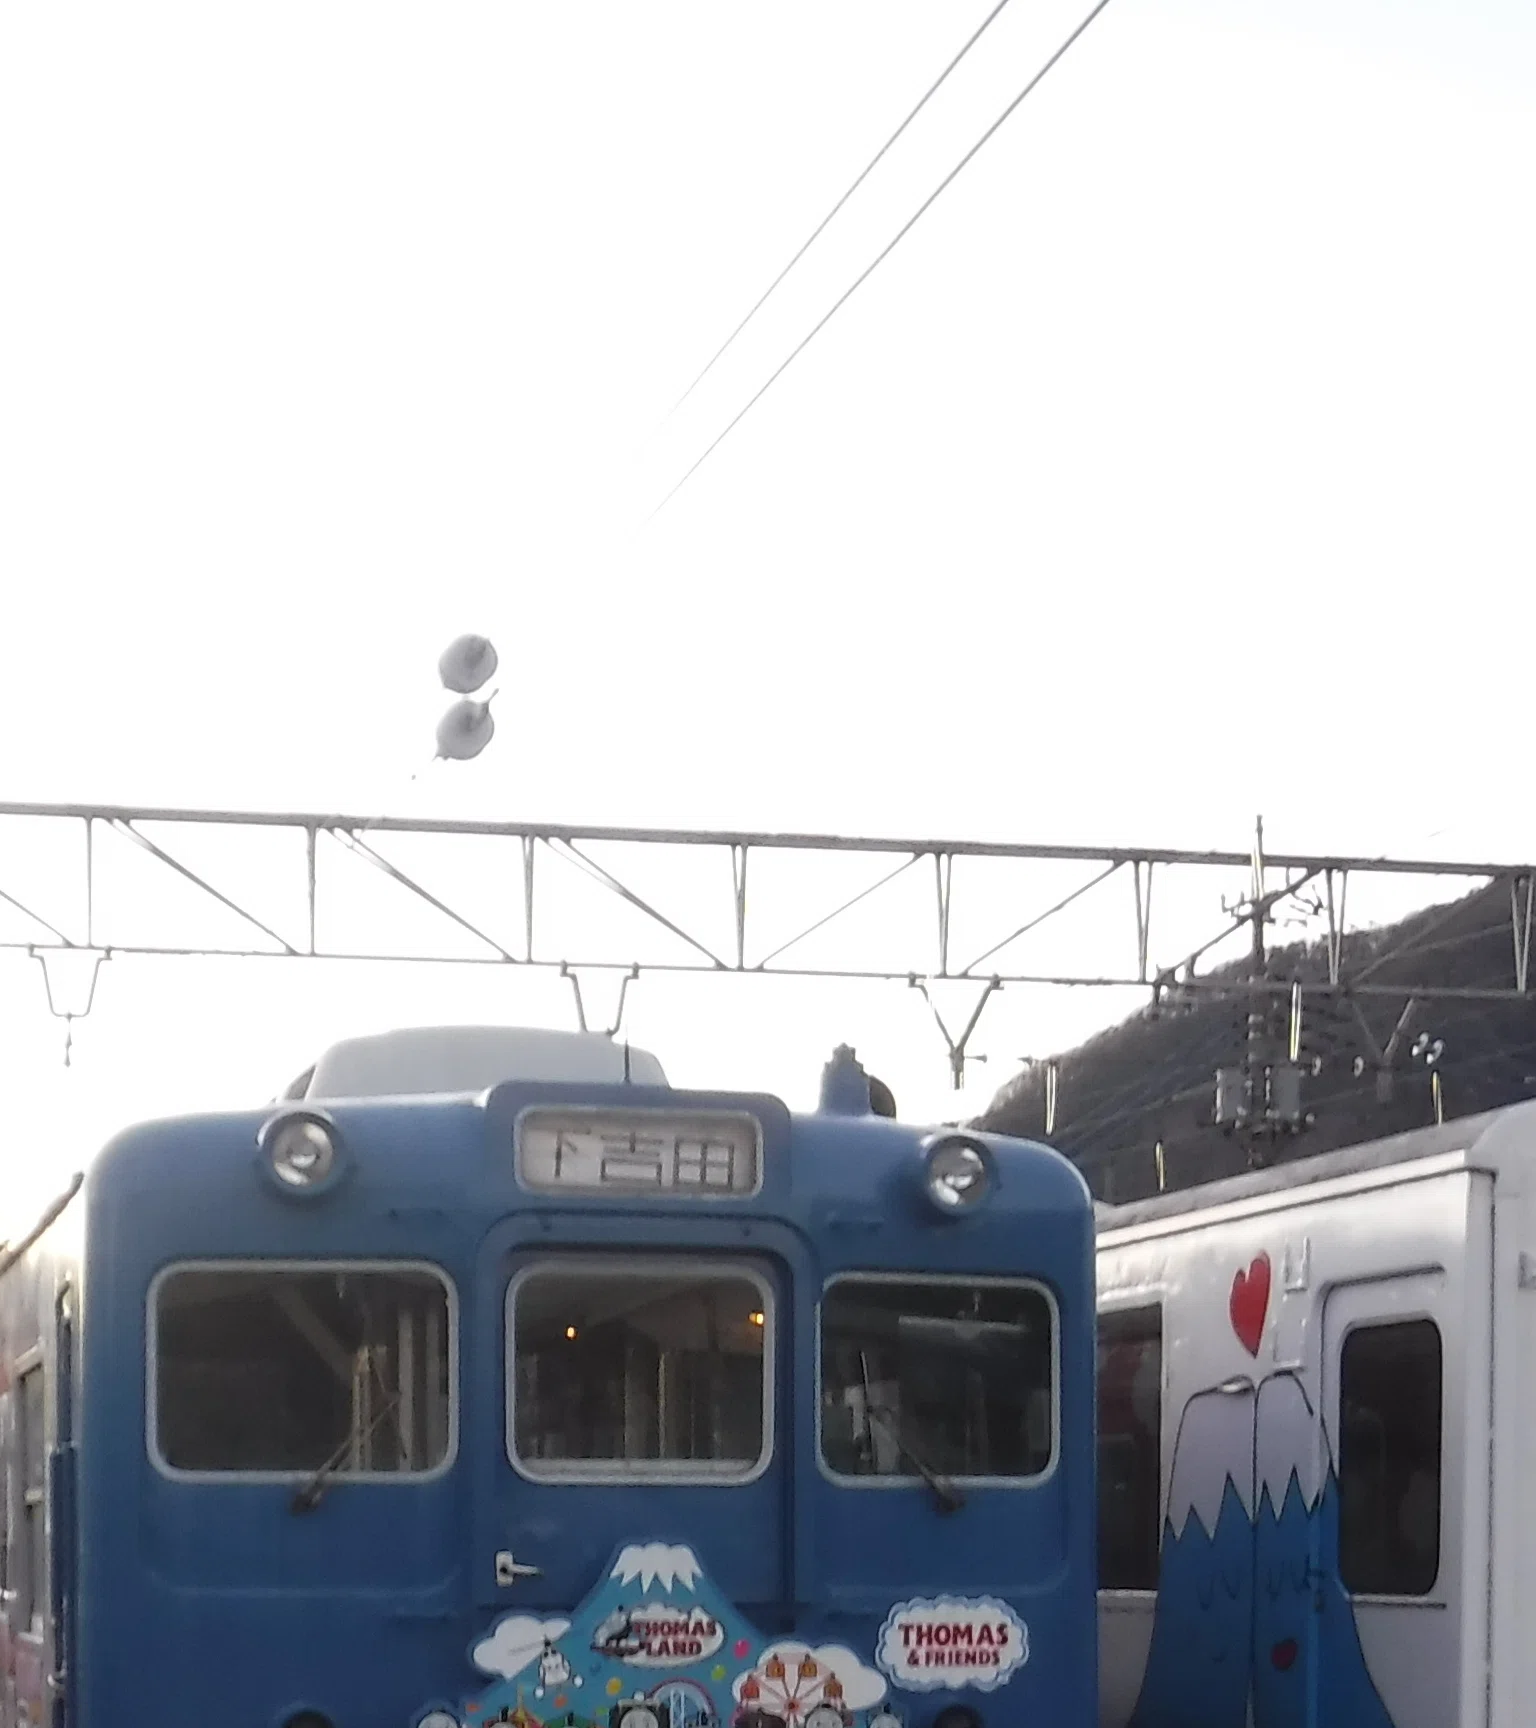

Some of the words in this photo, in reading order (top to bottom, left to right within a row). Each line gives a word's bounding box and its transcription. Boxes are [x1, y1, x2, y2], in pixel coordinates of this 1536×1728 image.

[532, 1128, 735, 1191] 下吉田
[632, 1620, 717, 1637] THOMAS
[898, 1622, 1009, 1647] THOMAS
[642, 1641, 703, 1657] LAND
[907, 1649, 920, 1666] &
[924, 1650, 1001, 1667] FRIENDS
